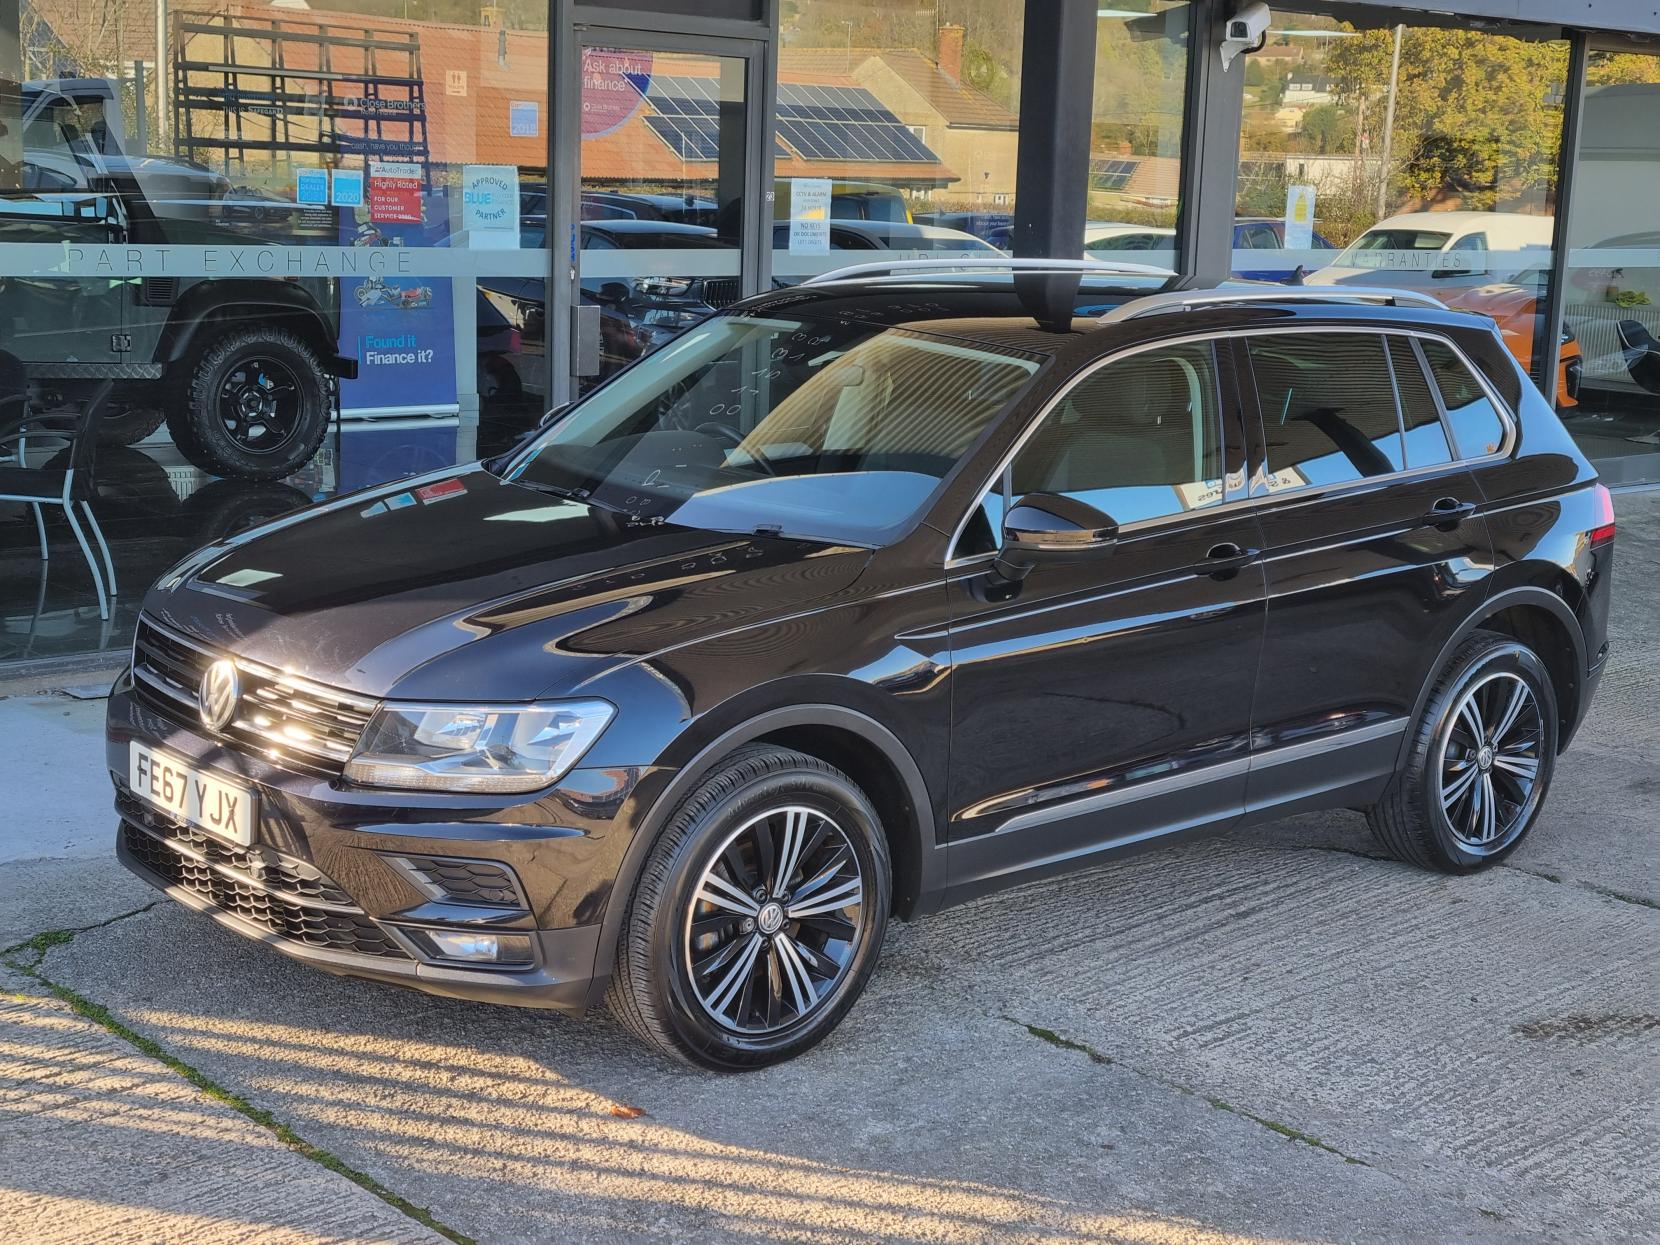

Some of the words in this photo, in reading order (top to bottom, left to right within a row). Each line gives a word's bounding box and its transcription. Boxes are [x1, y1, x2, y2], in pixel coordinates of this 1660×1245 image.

[584, 59, 606, 73] Ask
[609, 61, 642, 75] about
[584, 75, 625, 91] finance
[360, 98, 385, 108] Close
[387, 99, 425, 110] Brothers
[374, 180, 397, 190] Highly
[397, 181, 418, 189] Rated
[472, 176, 508, 190] APPROVED
[335, 191, 360, 203] 2020
[464, 191, 492, 205] BLUE
[475, 207, 507, 221] PARTNER
[68, 249, 172, 273] PART
[203, 249, 411, 273] EXCHANGE
[365, 335, 405, 349] Found
[407, 334, 417, 348] it
[366, 351, 416, 365] Finance
[417, 349, 434, 363] it?
[137, 752, 188, 809] FE67
[195, 779, 238, 834] YJX
